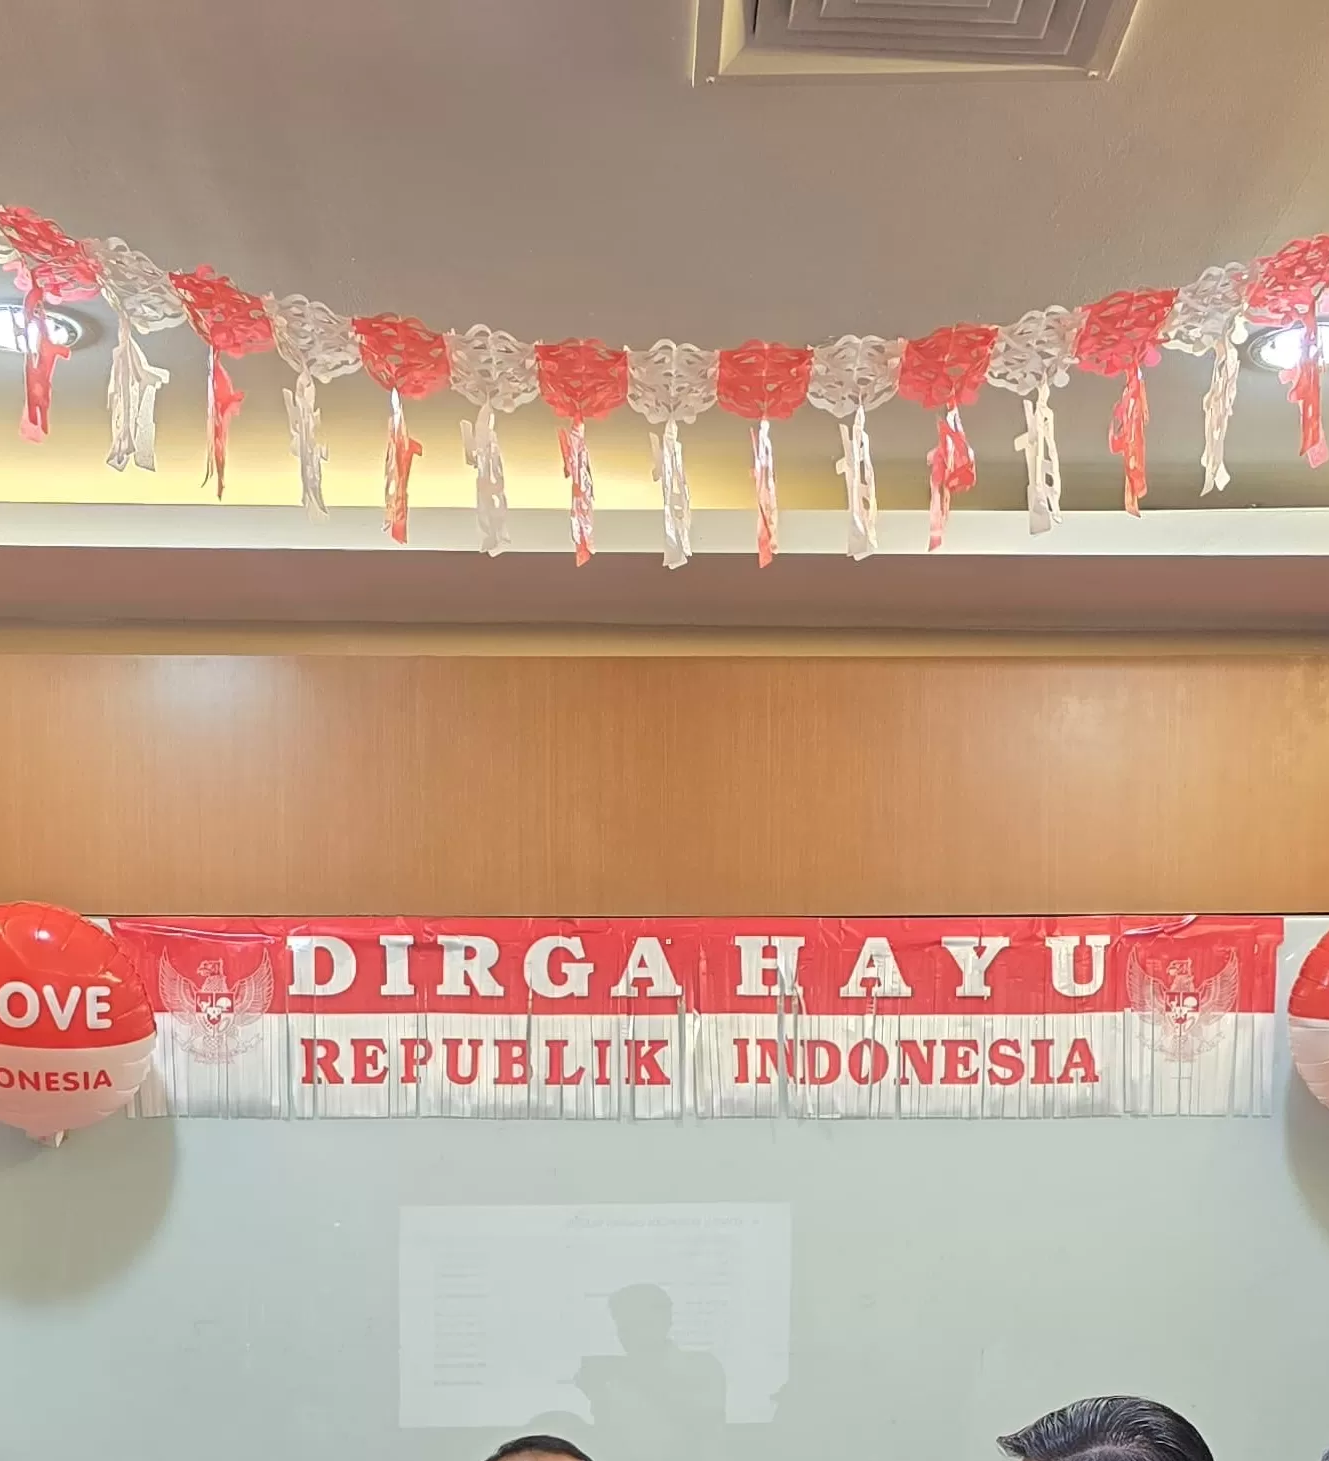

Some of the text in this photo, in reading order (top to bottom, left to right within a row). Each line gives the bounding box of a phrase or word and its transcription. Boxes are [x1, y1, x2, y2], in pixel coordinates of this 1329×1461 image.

[286, 934, 1110, 998] DIRGA HAYU
[300, 1036, 1099, 1086] REPUBLIK INDONESIA
